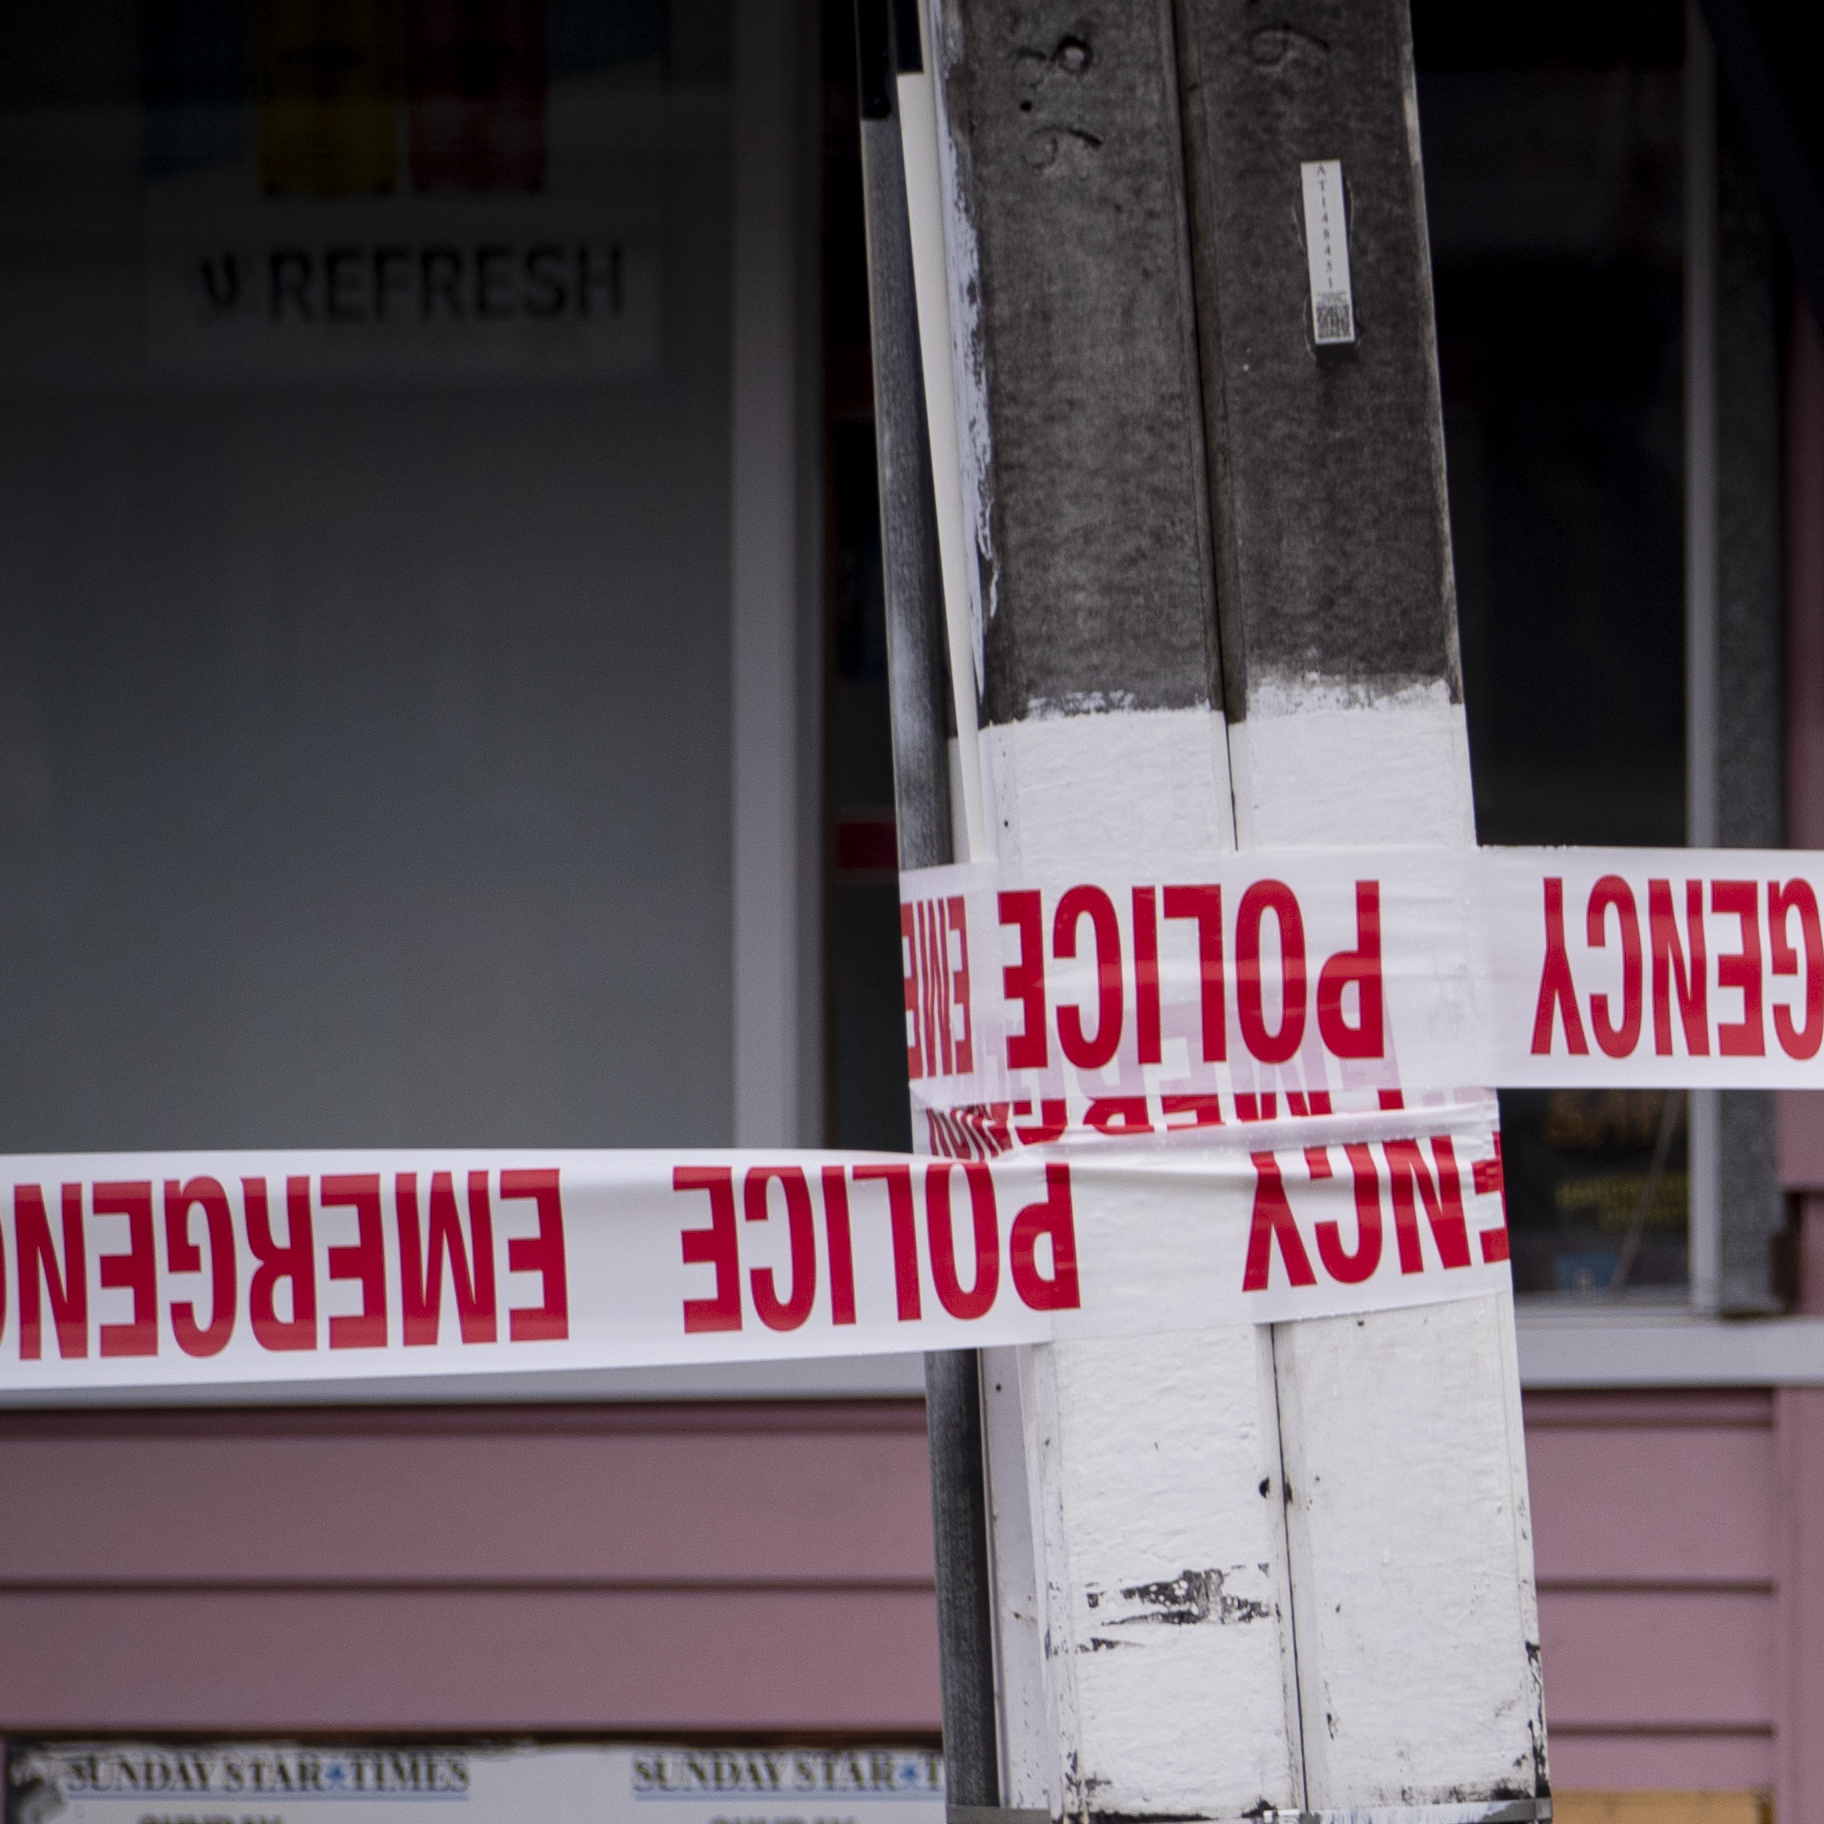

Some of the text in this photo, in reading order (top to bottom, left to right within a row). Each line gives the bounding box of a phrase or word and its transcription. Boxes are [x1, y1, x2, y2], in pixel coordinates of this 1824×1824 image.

[270, 243, 626, 322] REFRESH
[998, 879, 1385, 1071] POLICE
[0, 1168, 569, 1360] EMERGEN
[673, 1160, 1081, 1334] POLICE
[69, 1753, 470, 1791] SUNDAY STAR TIMES
[633, 1752, 784, 1791] SUNDAY
[795, 1752, 896, 1791] STAR
